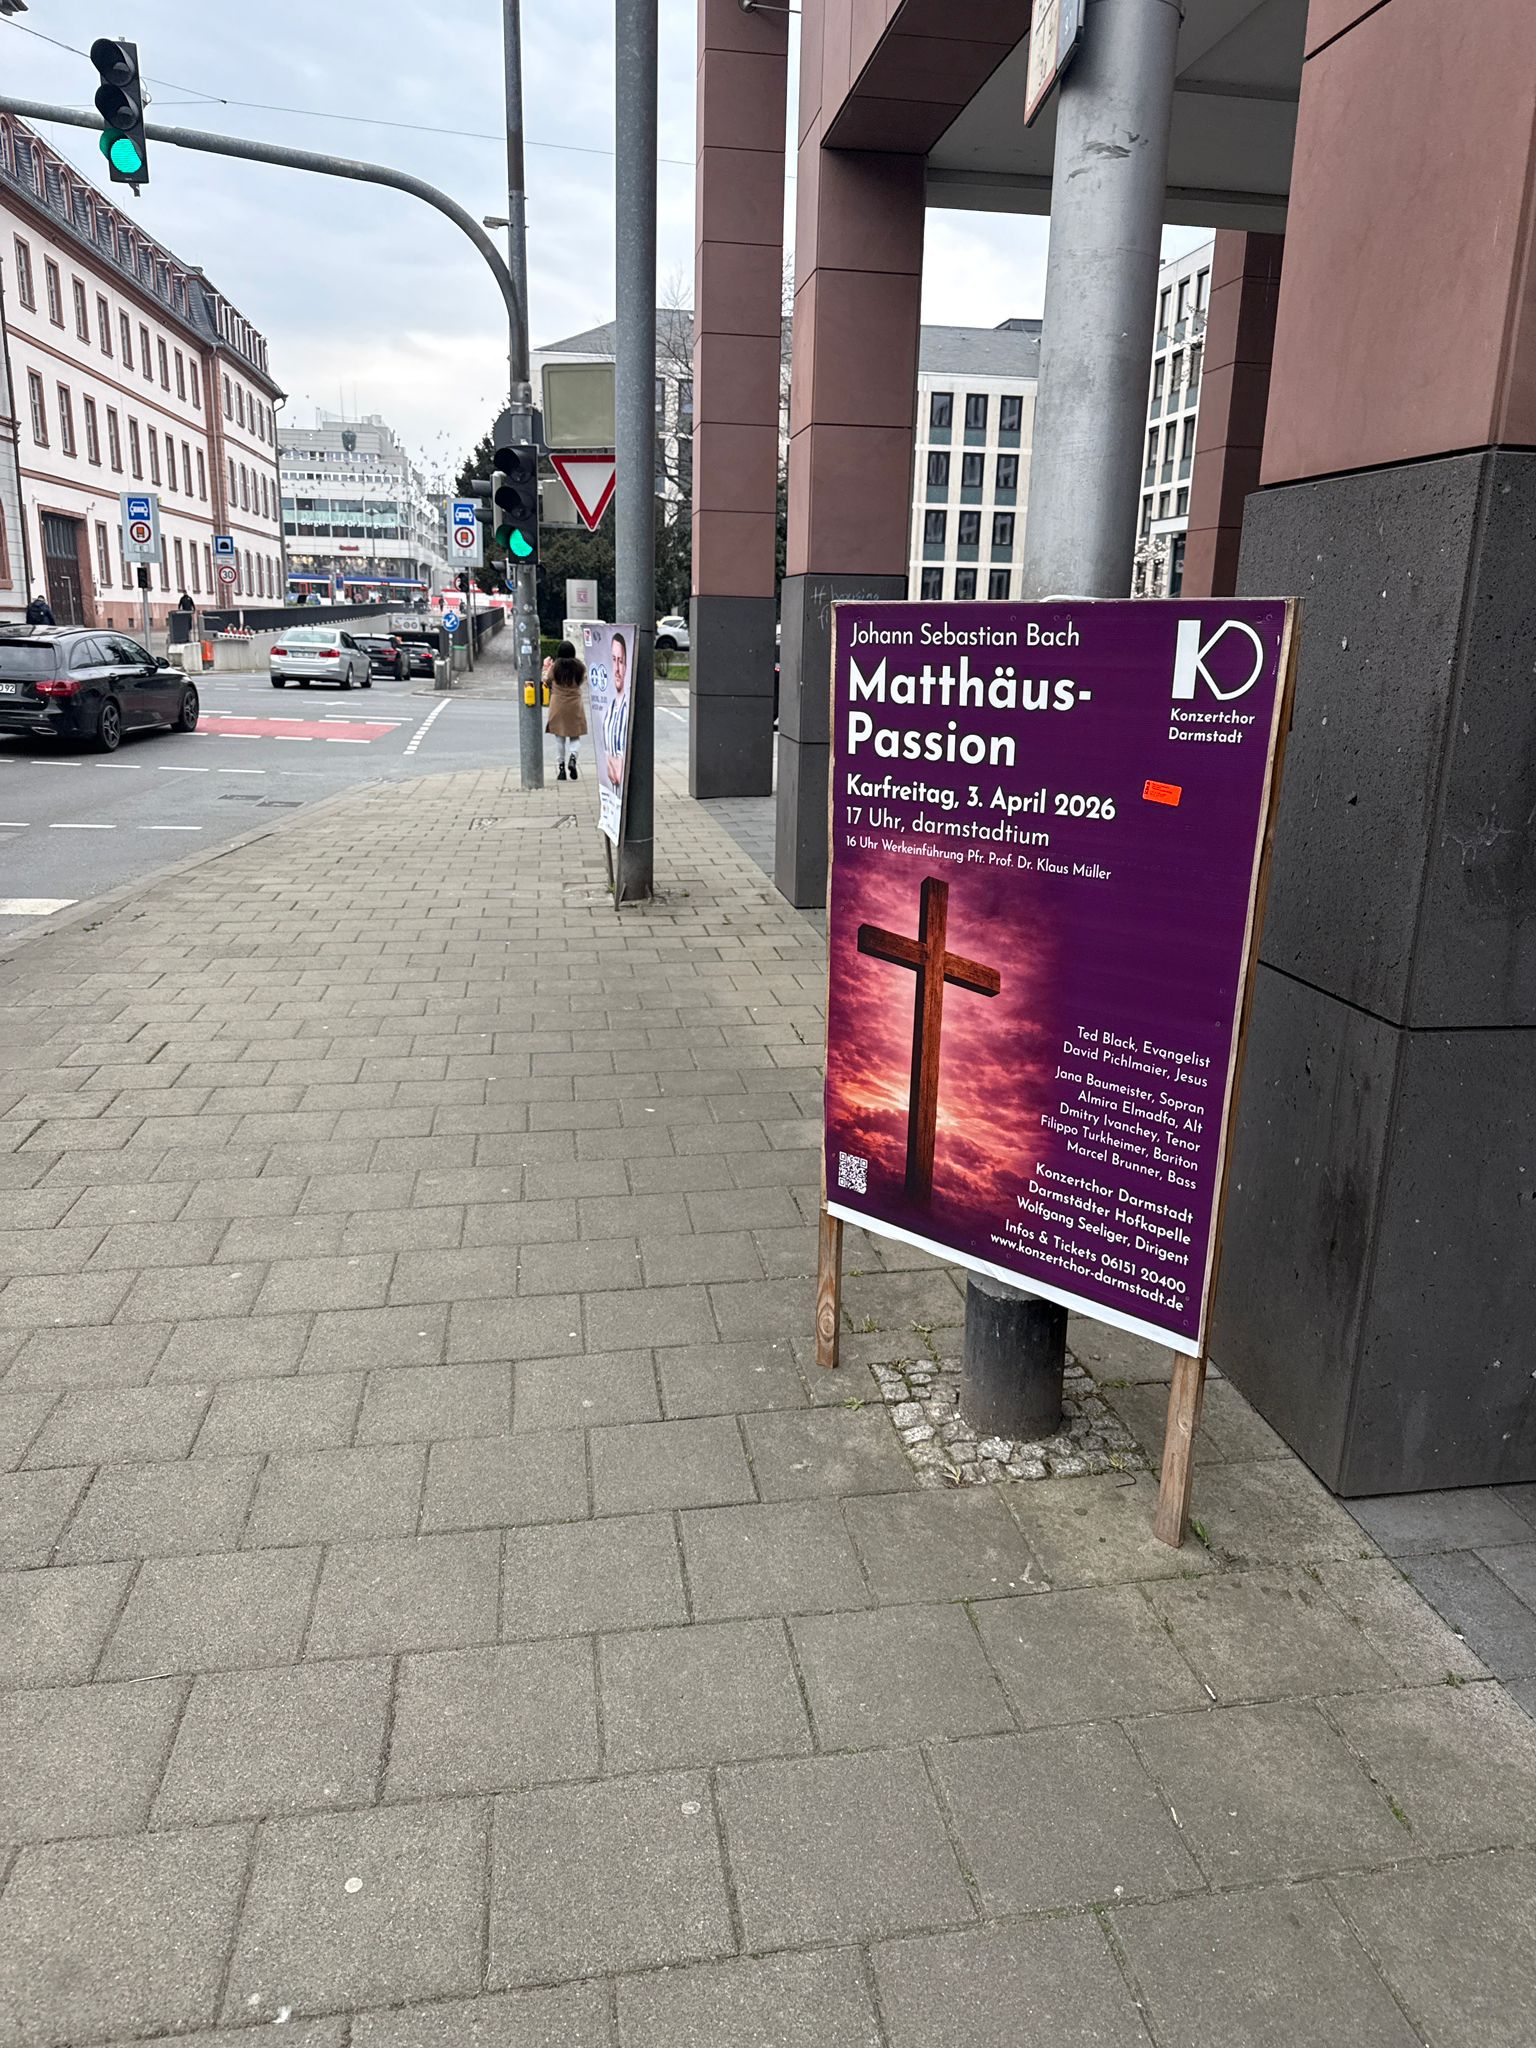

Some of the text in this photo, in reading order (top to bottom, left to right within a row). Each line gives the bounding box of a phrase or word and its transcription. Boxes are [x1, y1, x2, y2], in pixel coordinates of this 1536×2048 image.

[222, 570, 234, 579] 30
[849, 620, 1080, 648] Johann Sebastian Bach
[849, 655, 1092, 711] Matthäus-
[847, 710, 1016, 767] Passion
[1168, 726, 1243, 743] Darmstadt
[1170, 707, 1255, 725] Konzertchor
[847, 773, 1116, 820] Karfreitag, 3. April 2026
[846, 806, 1049, 847] 17 Uhr, darmstadtium
[846, 835, 1112, 880] 16 Uhr Werkeinführung Pfr. Prof. Dr. Klaus Müller
[1063, 1040, 1208, 1087] David Pichlmaier, Jesus
[1077, 1025, 1211, 1068] Ted Black, Evangelist
[1054, 1065, 1204, 1115] Jana Baumeister, Sopran
[1077, 1090, 1203, 1134] Almira Elmadfa, Alt
[1040, 1114, 1198, 1171] Filippo Turkheimer, Bariton
[1059, 1101, 1201, 1152] Dmitry Ivanchey, Tenor
[1067, 1139, 1196, 1190] Marcel Brunner, Bass
[1028, 1179, 1191, 1245] Darmstädter Hofkapelle
[1036, 1162, 1194, 1224] Konzertchor Darmstadt
[1016, 1195, 1189, 1266] Wolfgang Seeliger, Dirigent
[990, 1234, 1184, 1312] www.konzertchor-darmstadt.de
[1005, 1218, 1186, 1294] Infos & Tickets 06151 20400
